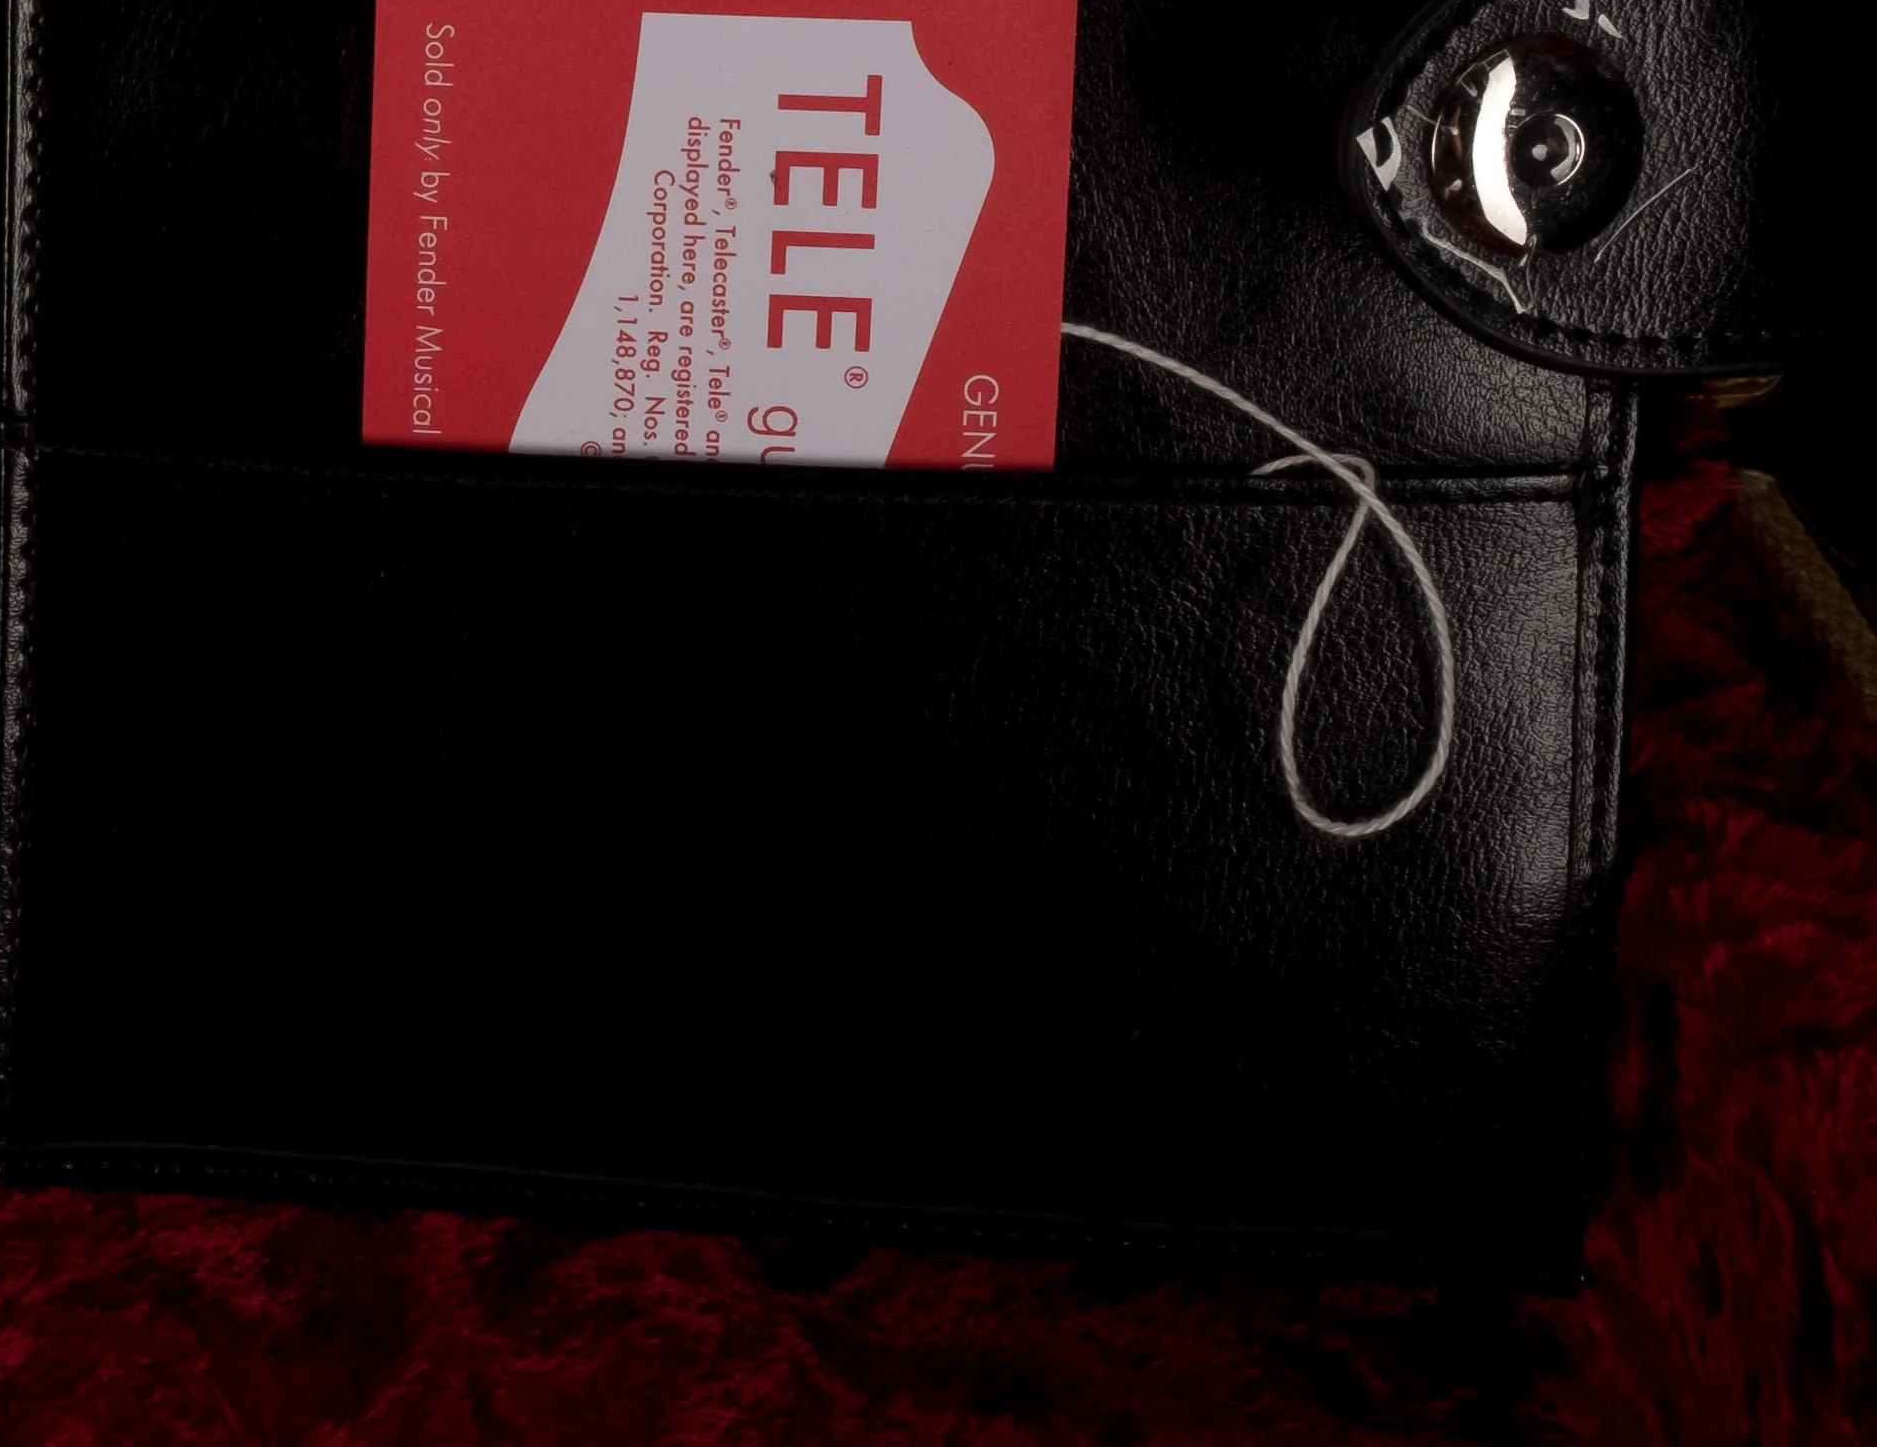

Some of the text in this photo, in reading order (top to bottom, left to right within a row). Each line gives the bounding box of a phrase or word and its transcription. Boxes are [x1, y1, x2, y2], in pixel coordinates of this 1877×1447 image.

[413, 23, 455, 433] Sold only by Fender Musical
[641, 171, 675, 445] Corporation. Reg. Nos.
[671, 117, 710, 456] displayed here, are registered
[610, 294, 638, 456] 1,148,870; an
[705, 430, 722, 461] an
